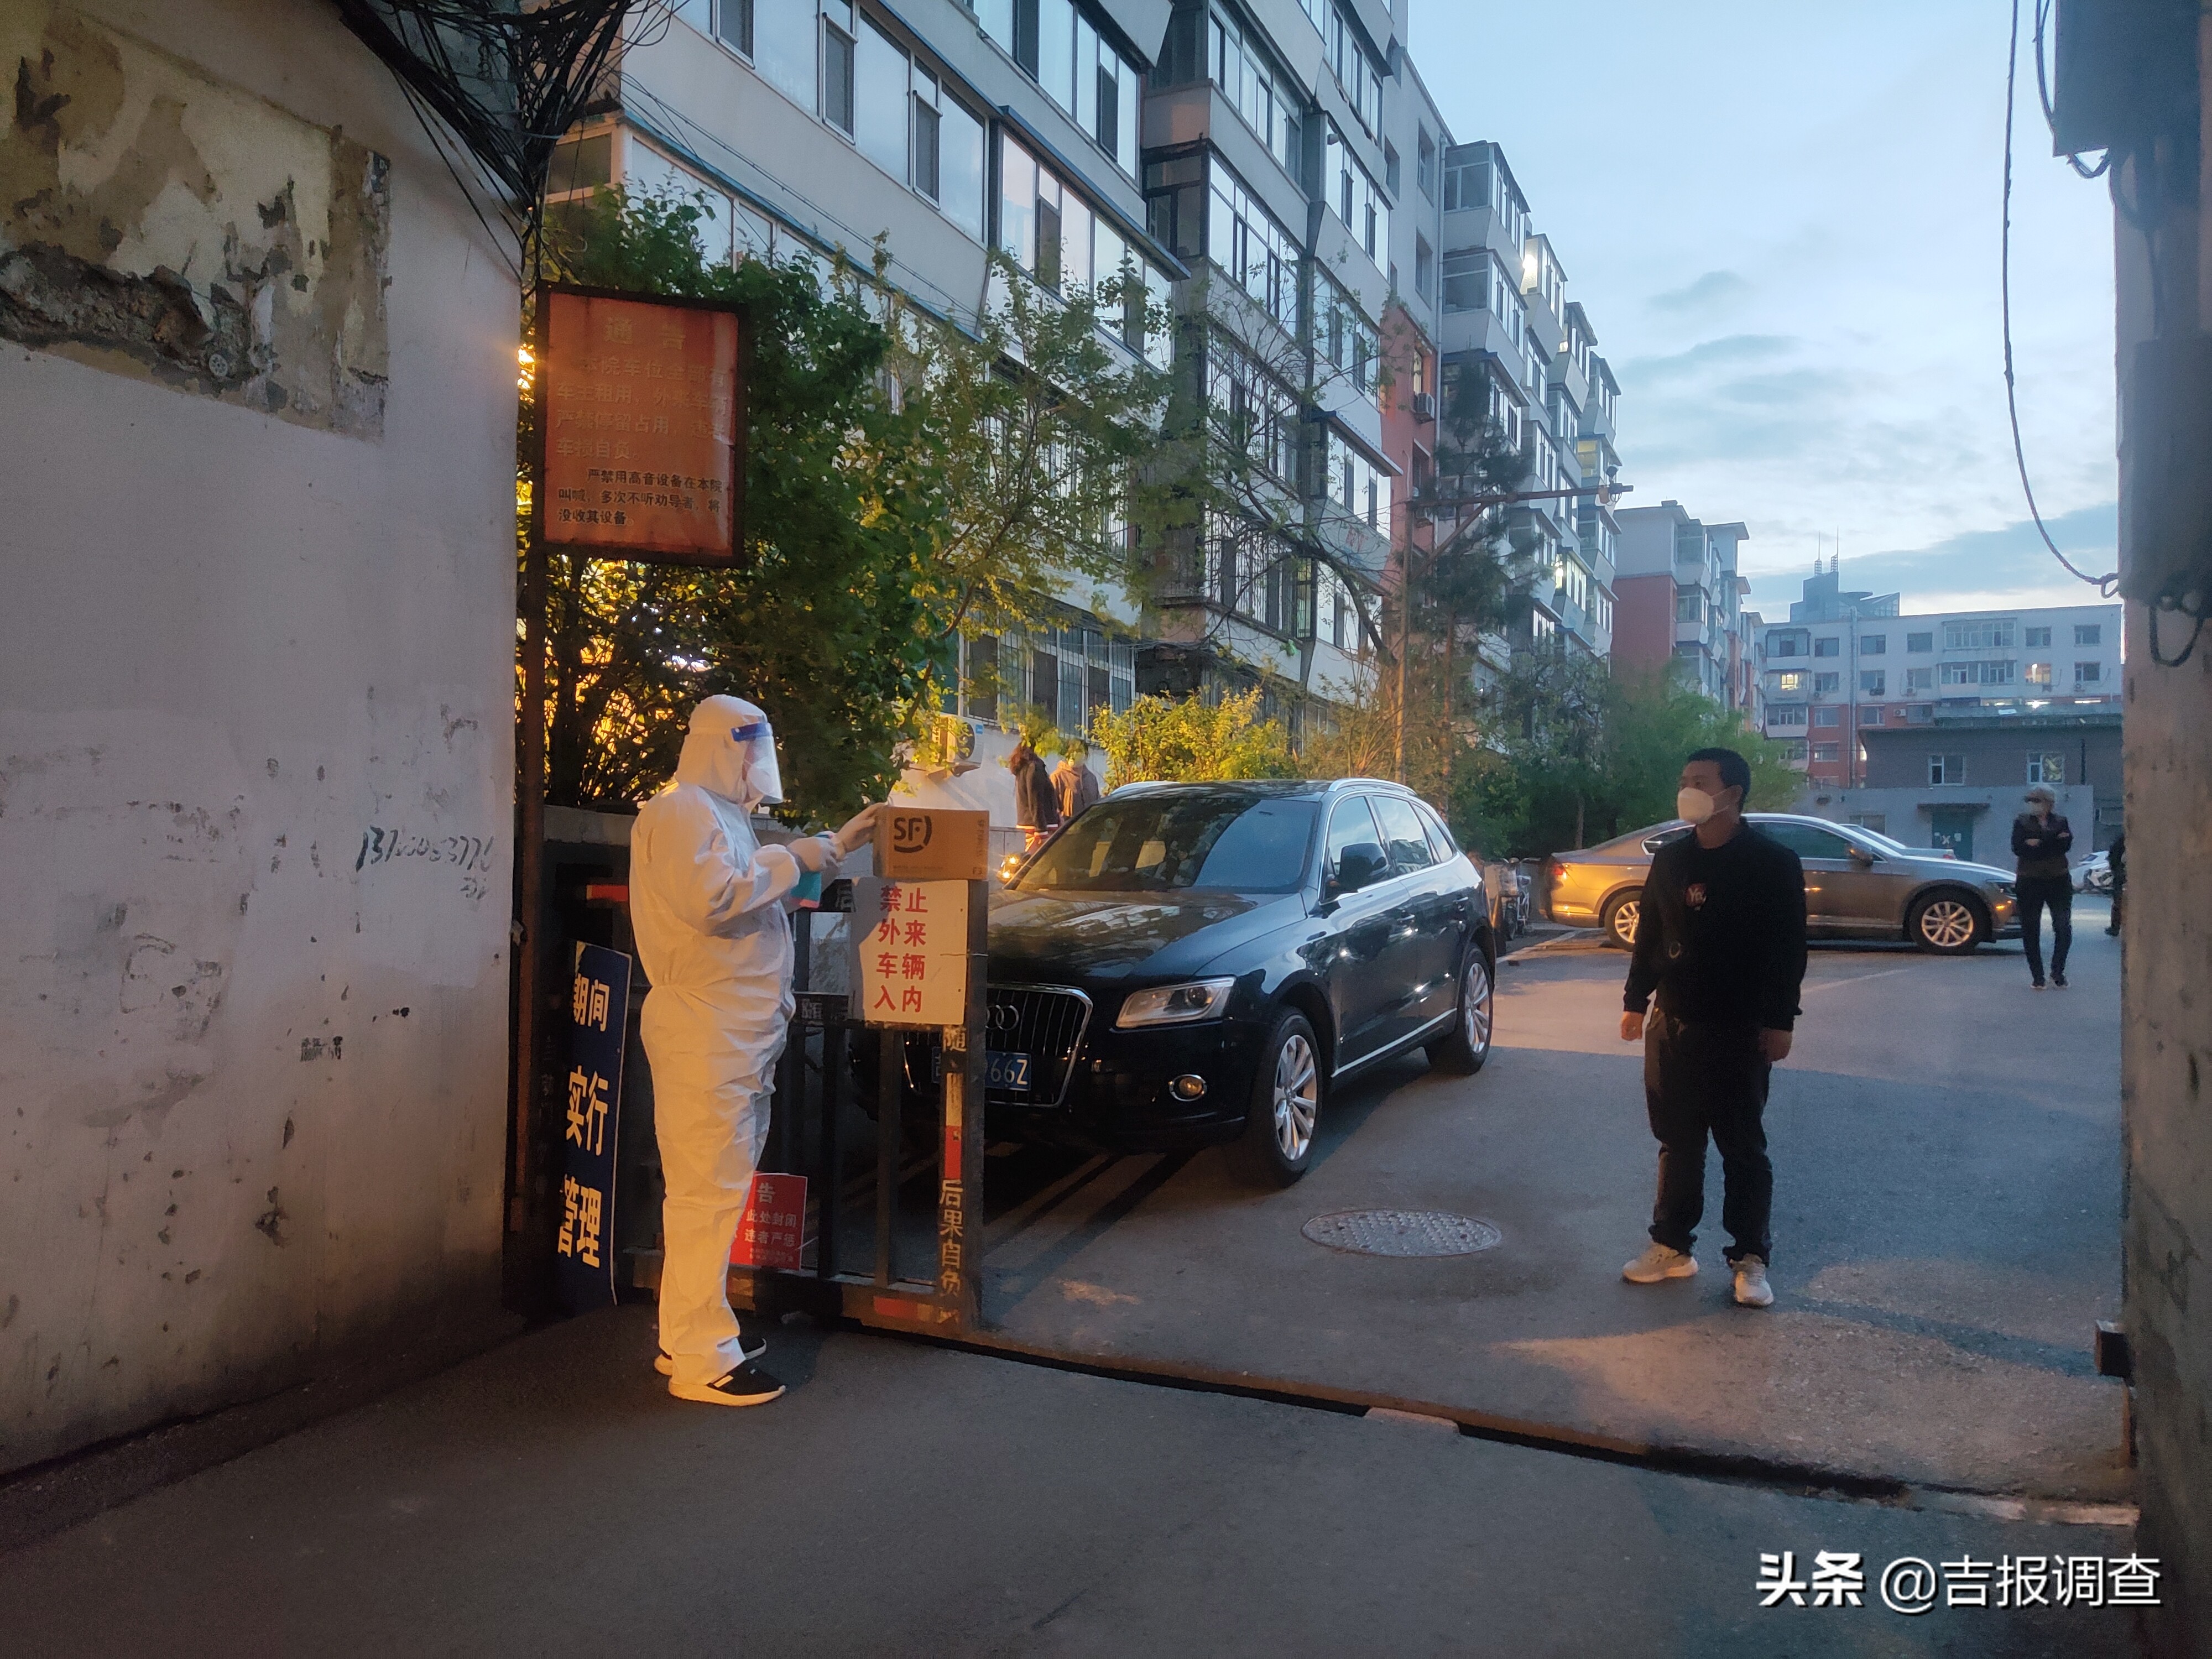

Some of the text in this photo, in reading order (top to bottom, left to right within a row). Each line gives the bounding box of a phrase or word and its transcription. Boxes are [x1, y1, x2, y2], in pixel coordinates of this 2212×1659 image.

[604, 316, 686, 350] 通告
[587, 468, 723, 493] 严禁用高音设备在本院
[880, 885, 928, 912] 禁止
[878, 918, 926, 947] 外来
[876, 952, 926, 980] 车辆
[874, 984, 922, 1013] 入内
[565, 1065, 609, 1156] 实行
[757, 1182, 776, 1204] 告
[557, 1173, 603, 1269] 管理
[746, 1208, 797, 1228] 此处封闭
[938, 1178, 964, 1297] 后果自负
